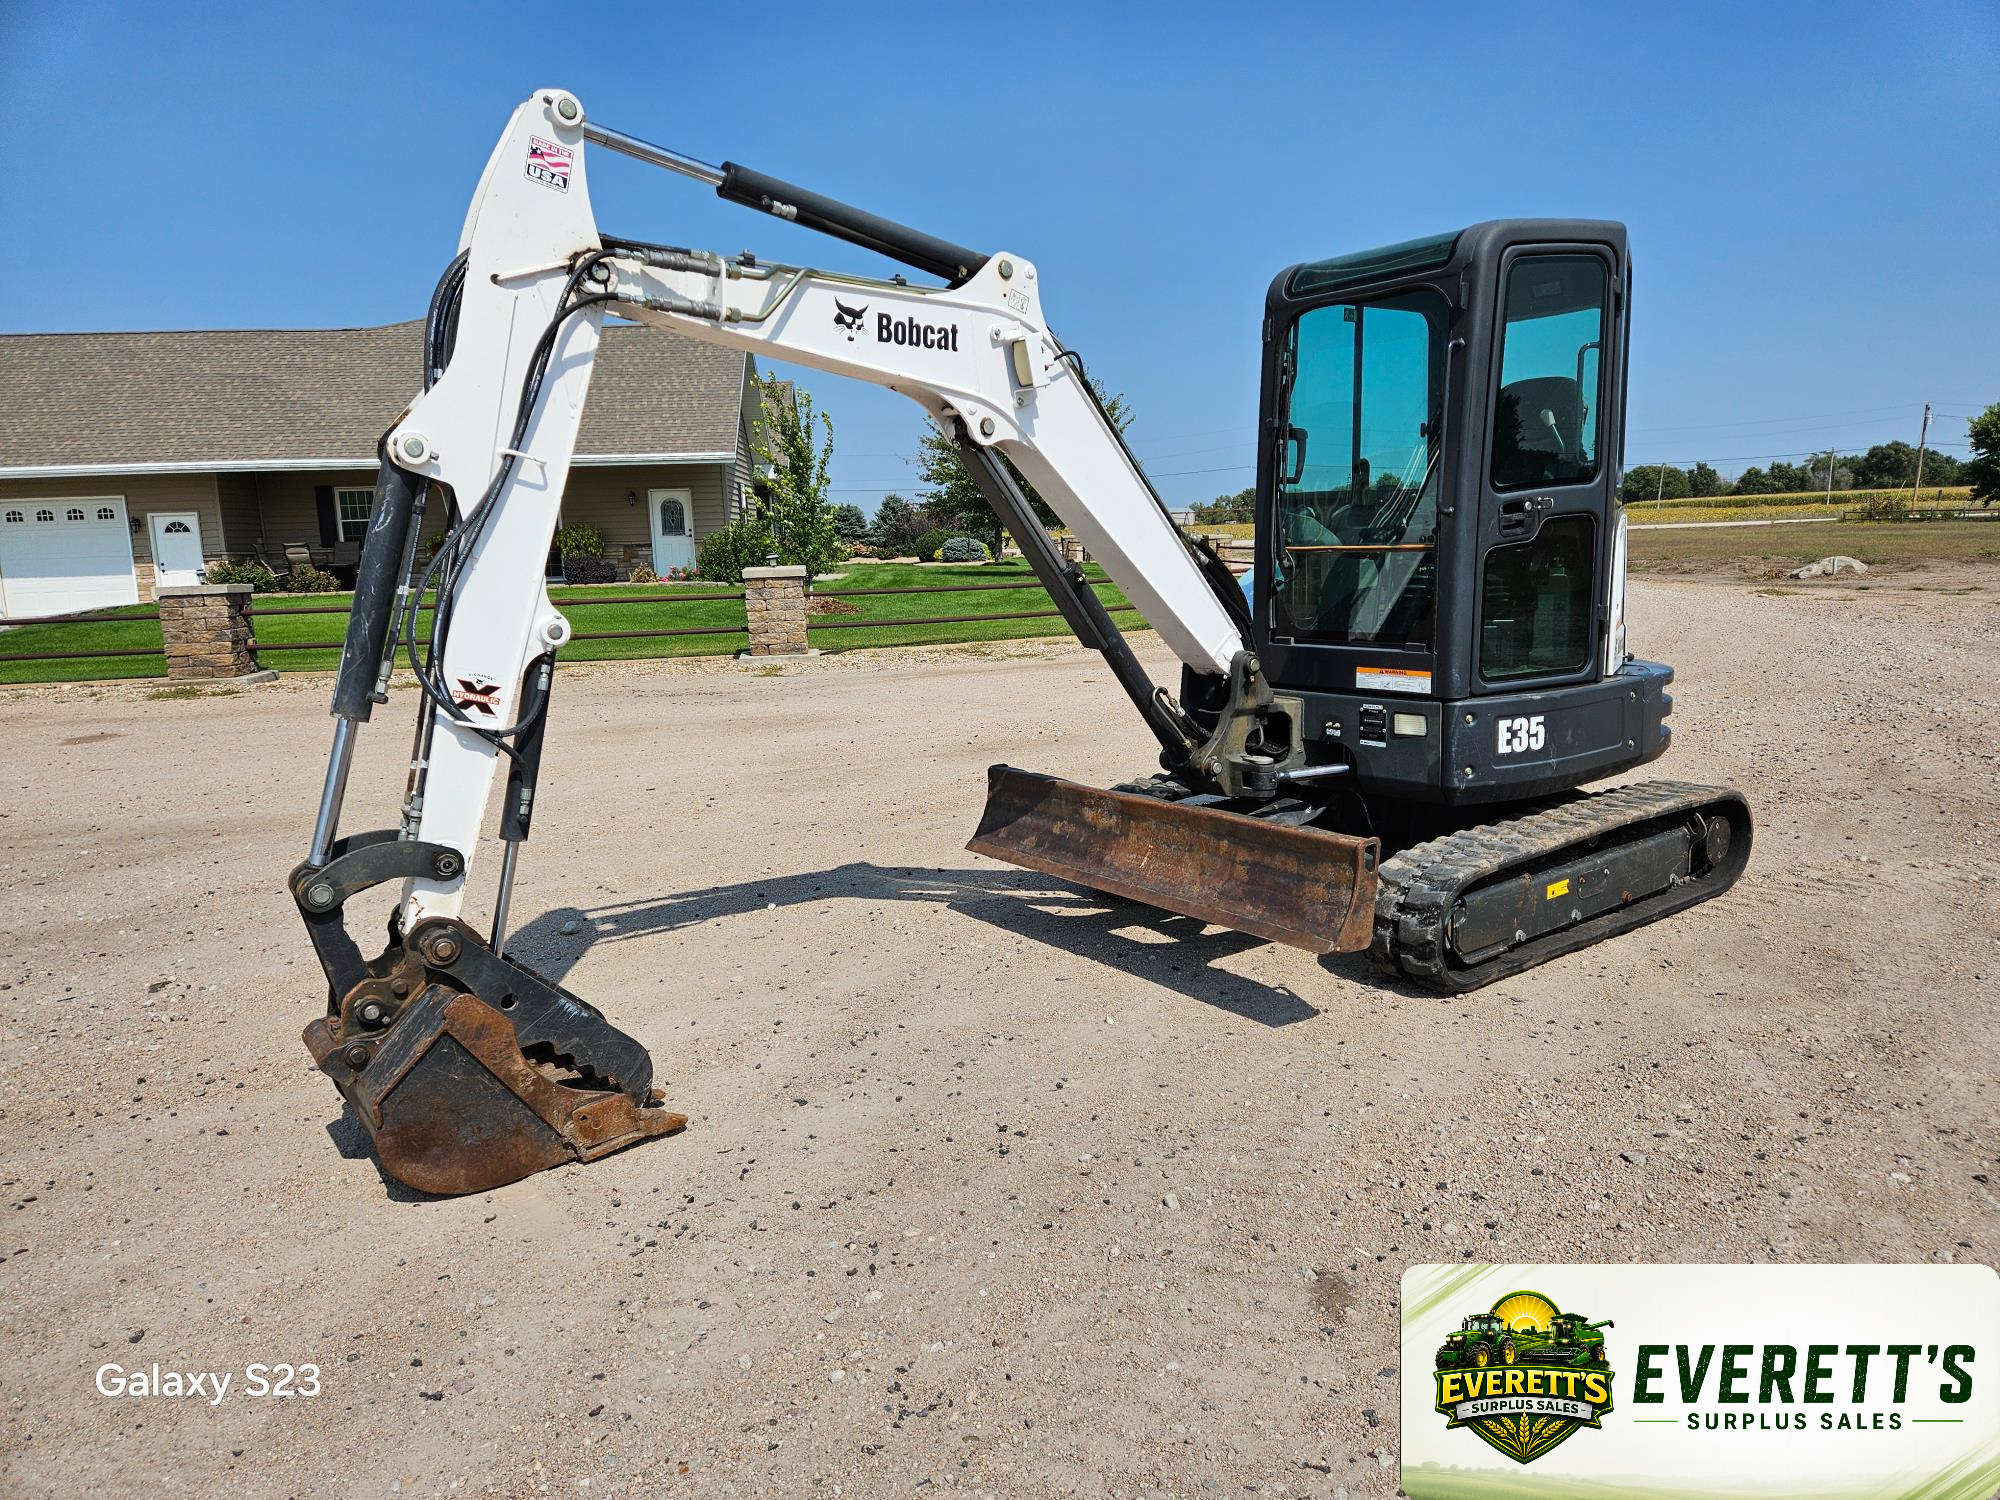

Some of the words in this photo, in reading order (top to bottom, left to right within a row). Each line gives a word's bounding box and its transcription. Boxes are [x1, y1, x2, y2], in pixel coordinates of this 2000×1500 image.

[533, 138, 551, 149] MADE
[559, 148, 570, 157] THE
[527, 164, 565, 189] USA
[877, 312, 959, 352] Bobcat
[452, 690, 500, 705] HYDRAULIC
[1498, 716, 1546, 754] E35
